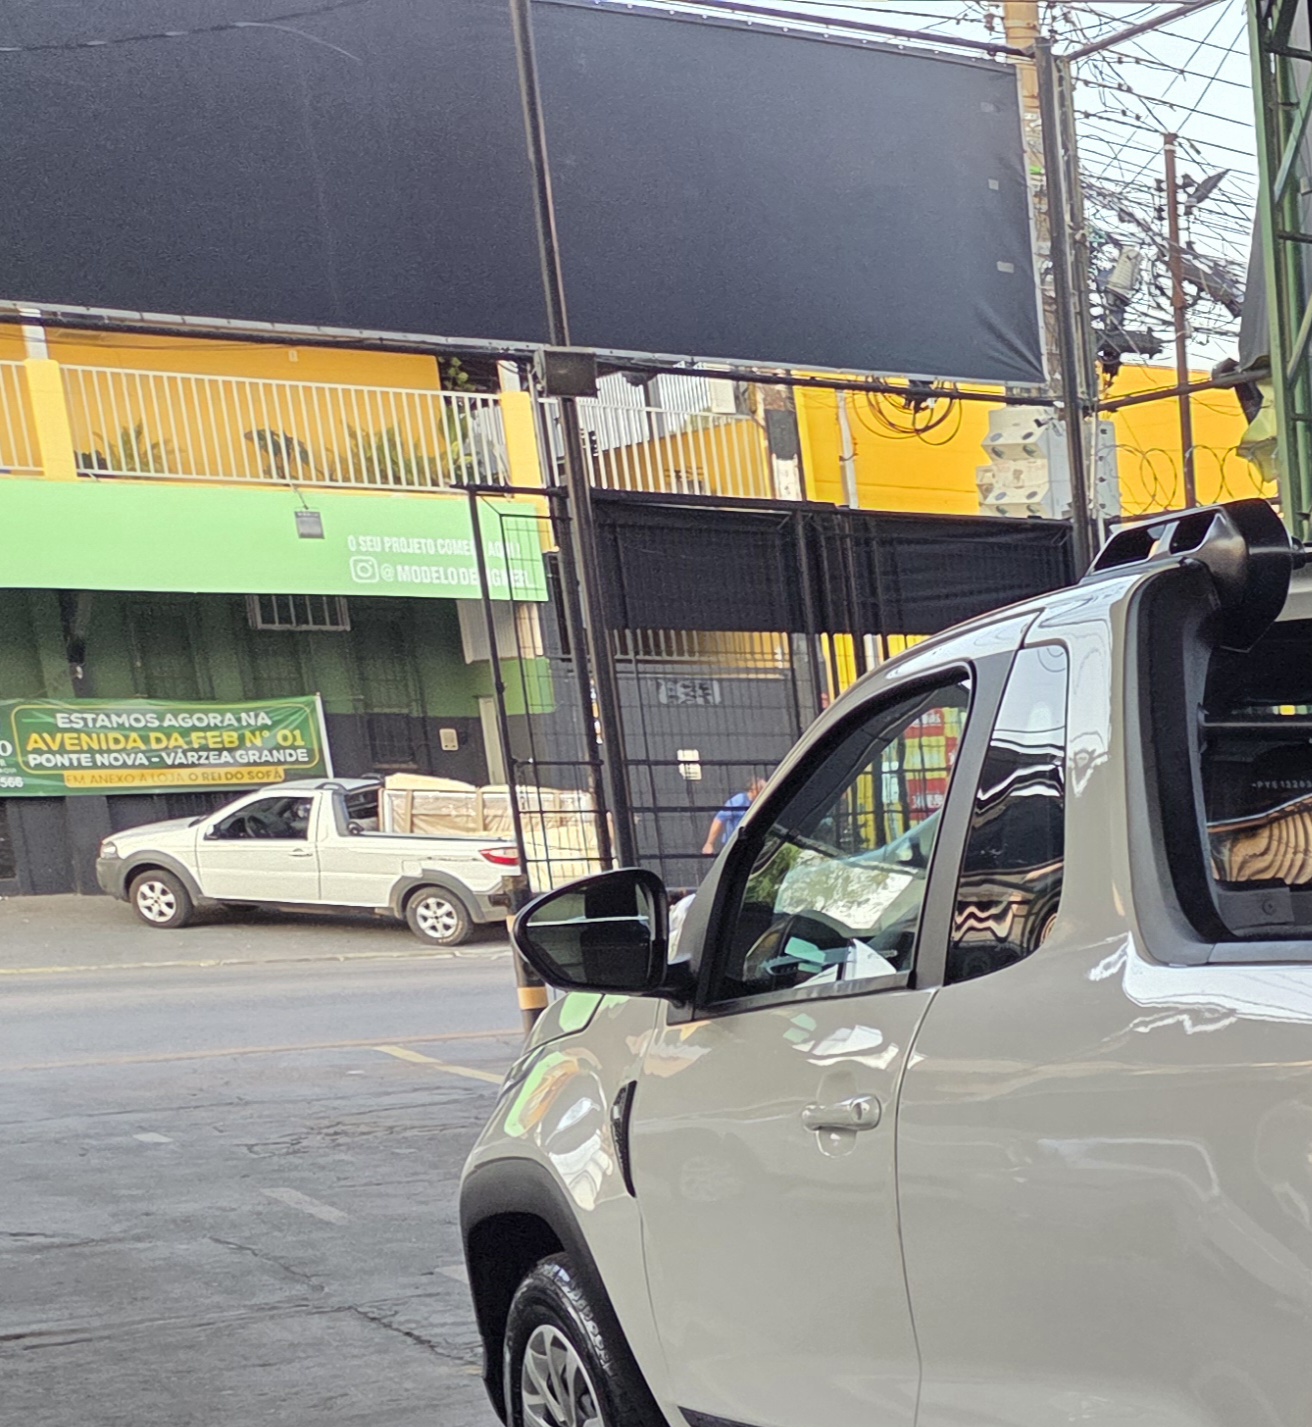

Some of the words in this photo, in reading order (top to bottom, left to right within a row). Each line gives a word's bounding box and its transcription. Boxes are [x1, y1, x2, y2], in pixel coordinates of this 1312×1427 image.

[347, 535, 356, 551] O
[358, 536, 381, 552] SEU
[384, 536, 435, 554] PROJETO
[437, 538, 483, 556] COME
[56, 713, 159, 728] ESTAMOS
[163, 713, 238, 727] AGORA
[241, 712, 272, 725] NA
[26, 732, 146, 751] AVENIDA
[149, 732, 187, 749] DA
[191, 731, 239, 748] FEB
[277, 729, 305, 746] 01
[28, 753, 93, 767] PONTE
[96, 752, 149, 766] NOVA
[162, 749, 234, 765] VÁRZEA
[235, 749, 309, 764] GRANDE
[66, 774, 85, 785] EM
[90, 773, 135, 785] ANEXO
[188, 772, 199, 782] O
[202, 771, 222, 781] REI
[224, 771, 245, 781] DO
